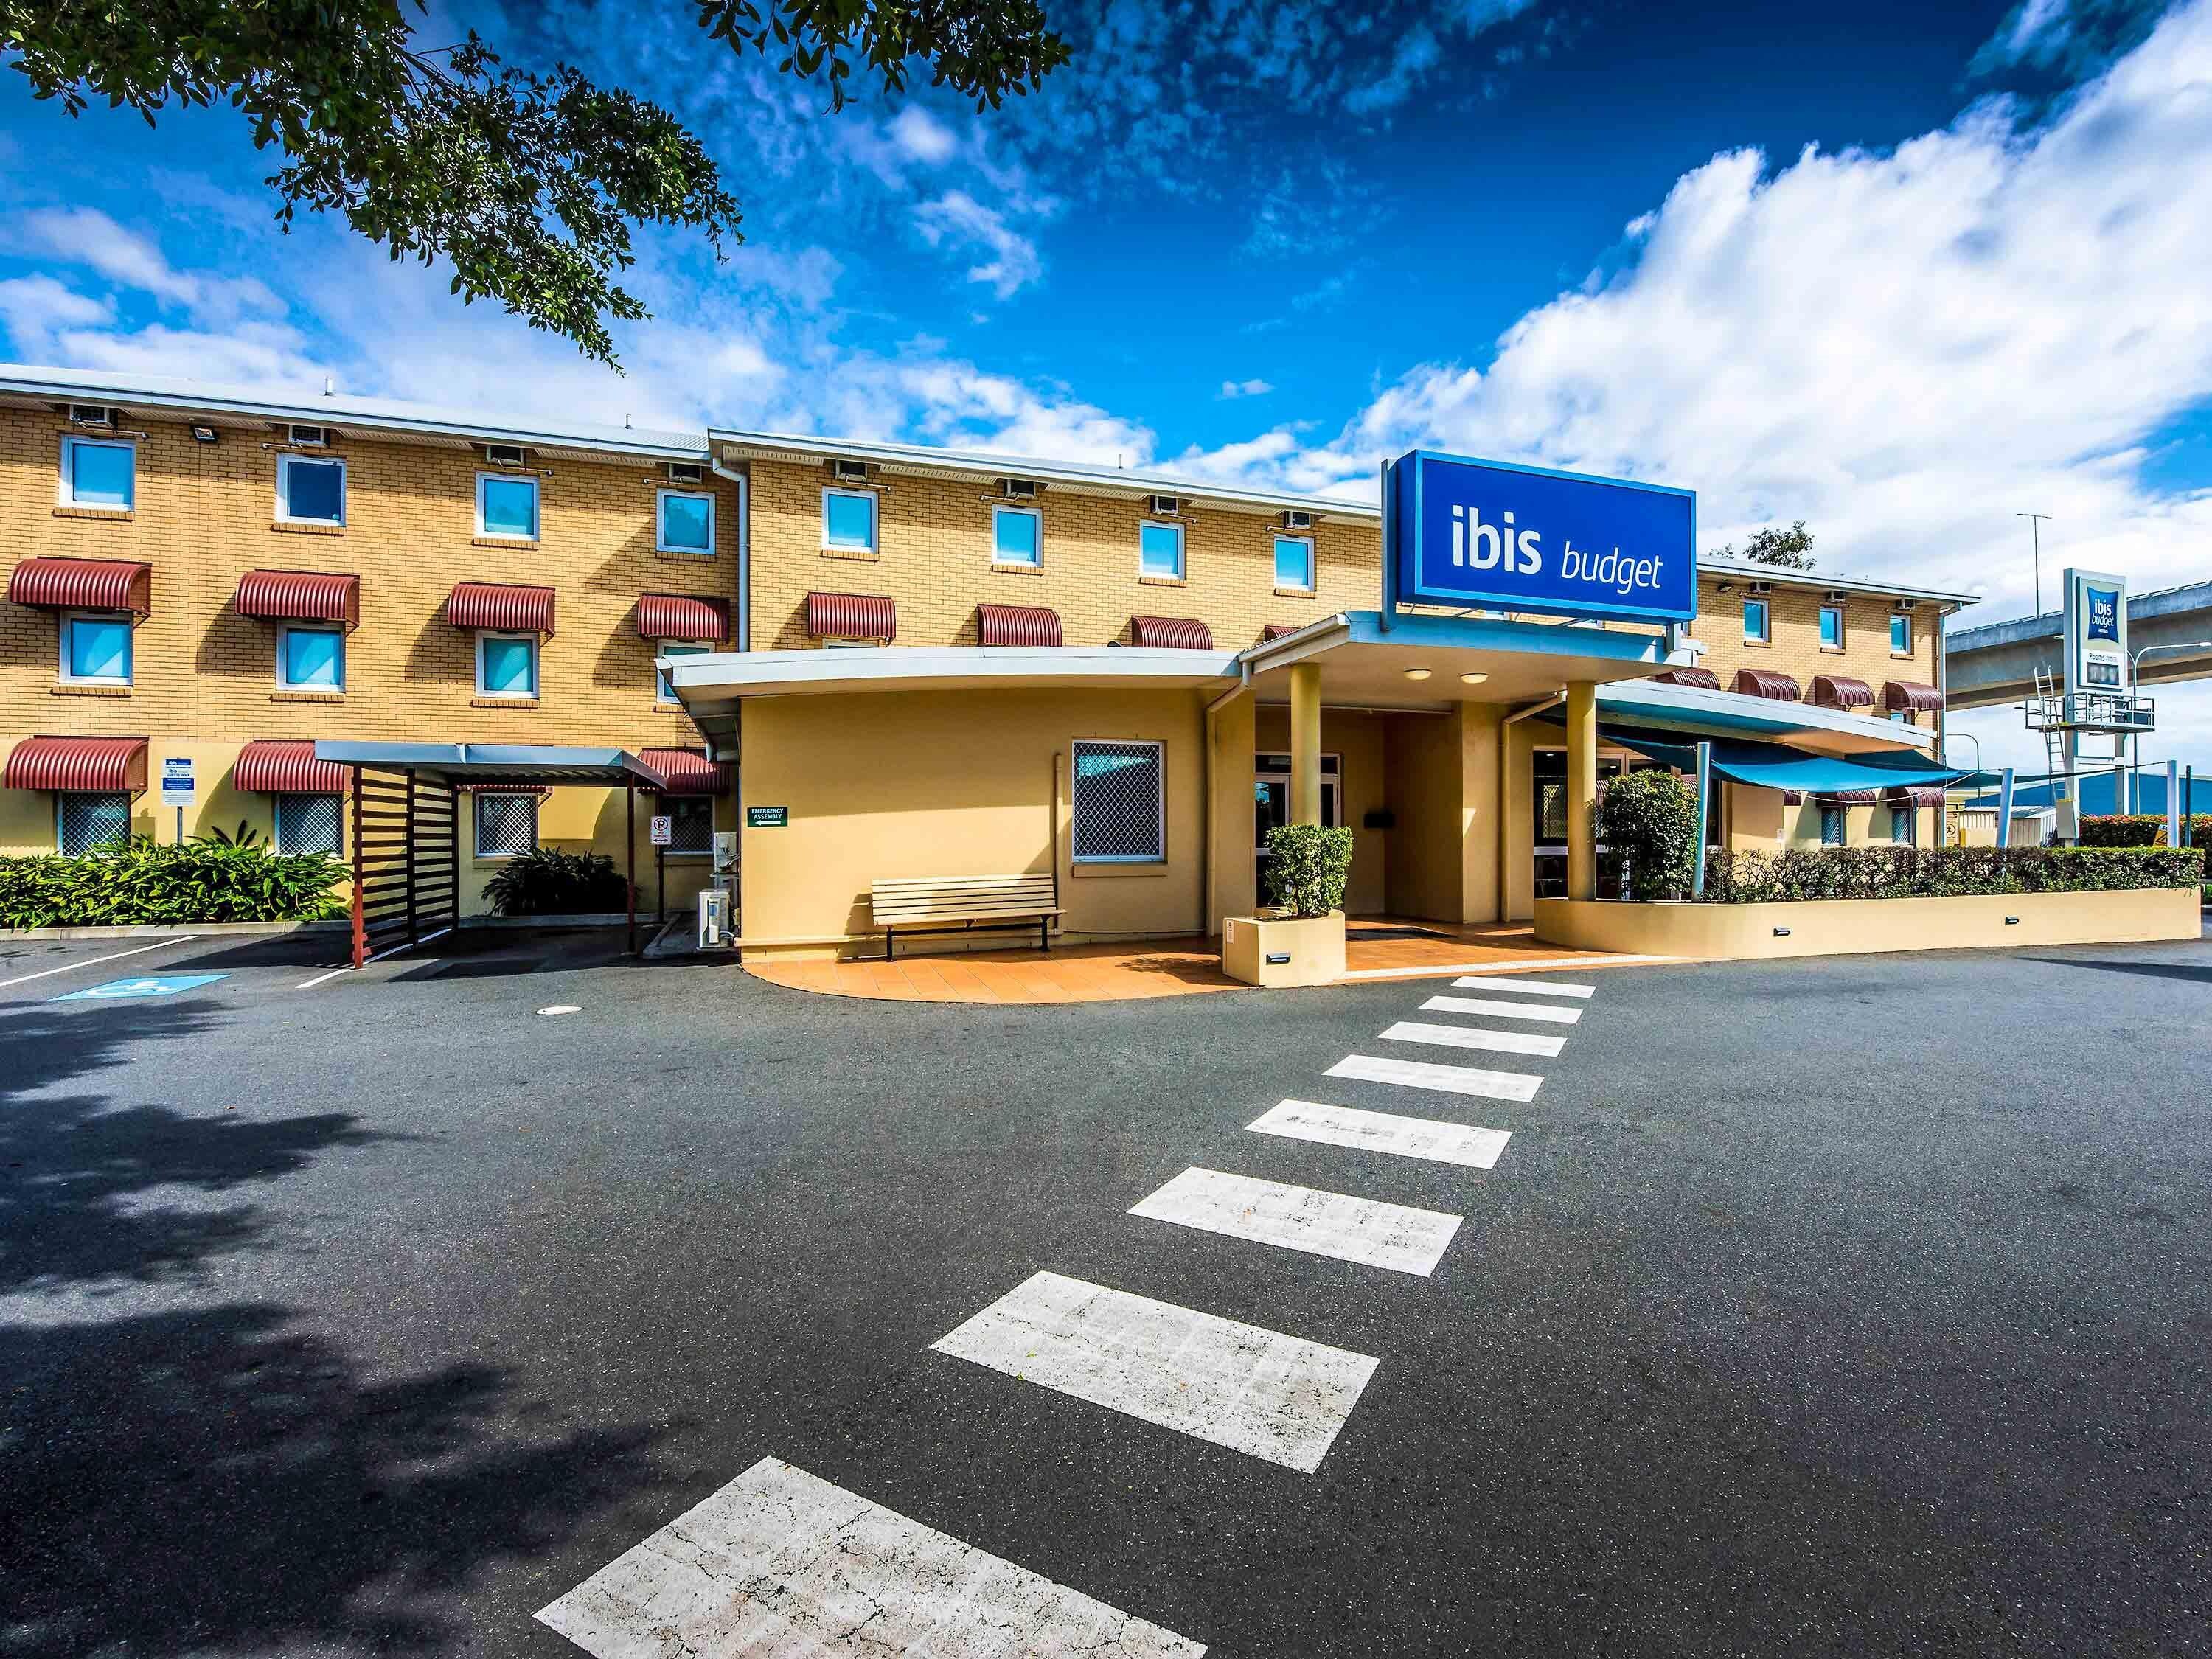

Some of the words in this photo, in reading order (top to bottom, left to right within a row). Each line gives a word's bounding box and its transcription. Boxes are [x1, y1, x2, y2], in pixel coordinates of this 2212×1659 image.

[1452, 504, 1543, 574] ibis
[1561, 540, 1664, 594] budget
[2094, 598, 2112, 616] ibis
[2091, 613, 2115, 628] budget
